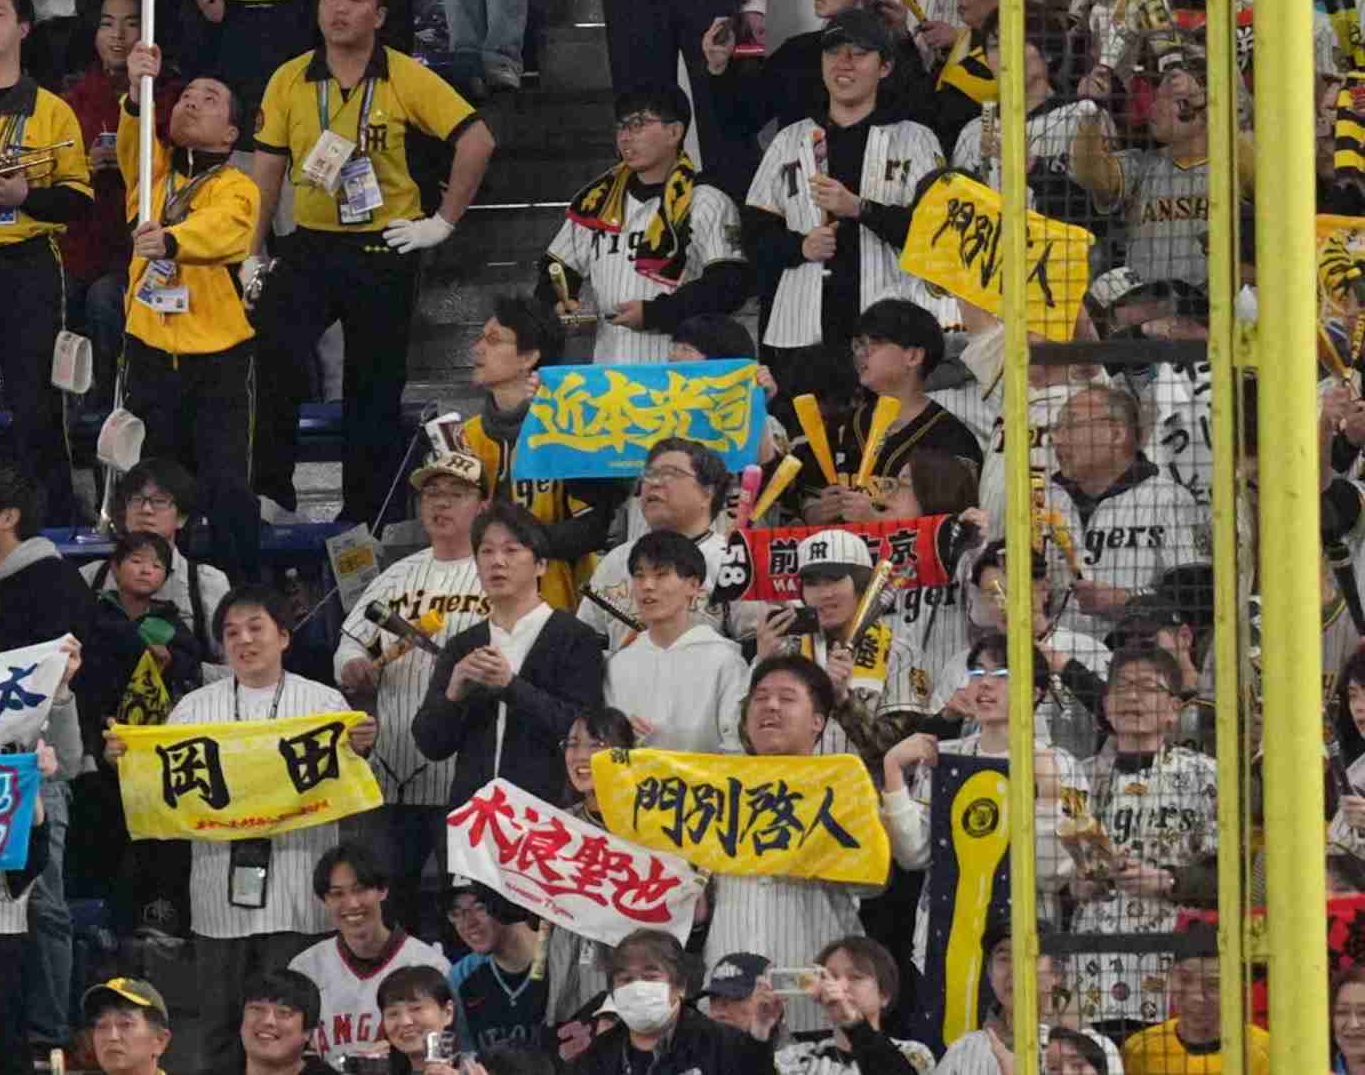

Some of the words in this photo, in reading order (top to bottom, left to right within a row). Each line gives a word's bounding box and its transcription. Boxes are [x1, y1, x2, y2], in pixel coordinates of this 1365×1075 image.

[528, 366, 757, 454] 近本光司
[719, 544, 746, 588] 58
[770, 532, 918, 575] 前京
[388, 587, 493, 623] Tigers
[634, 776, 861, 857] 門別啓人
[448, 786, 682, 923] 木浪聖也
